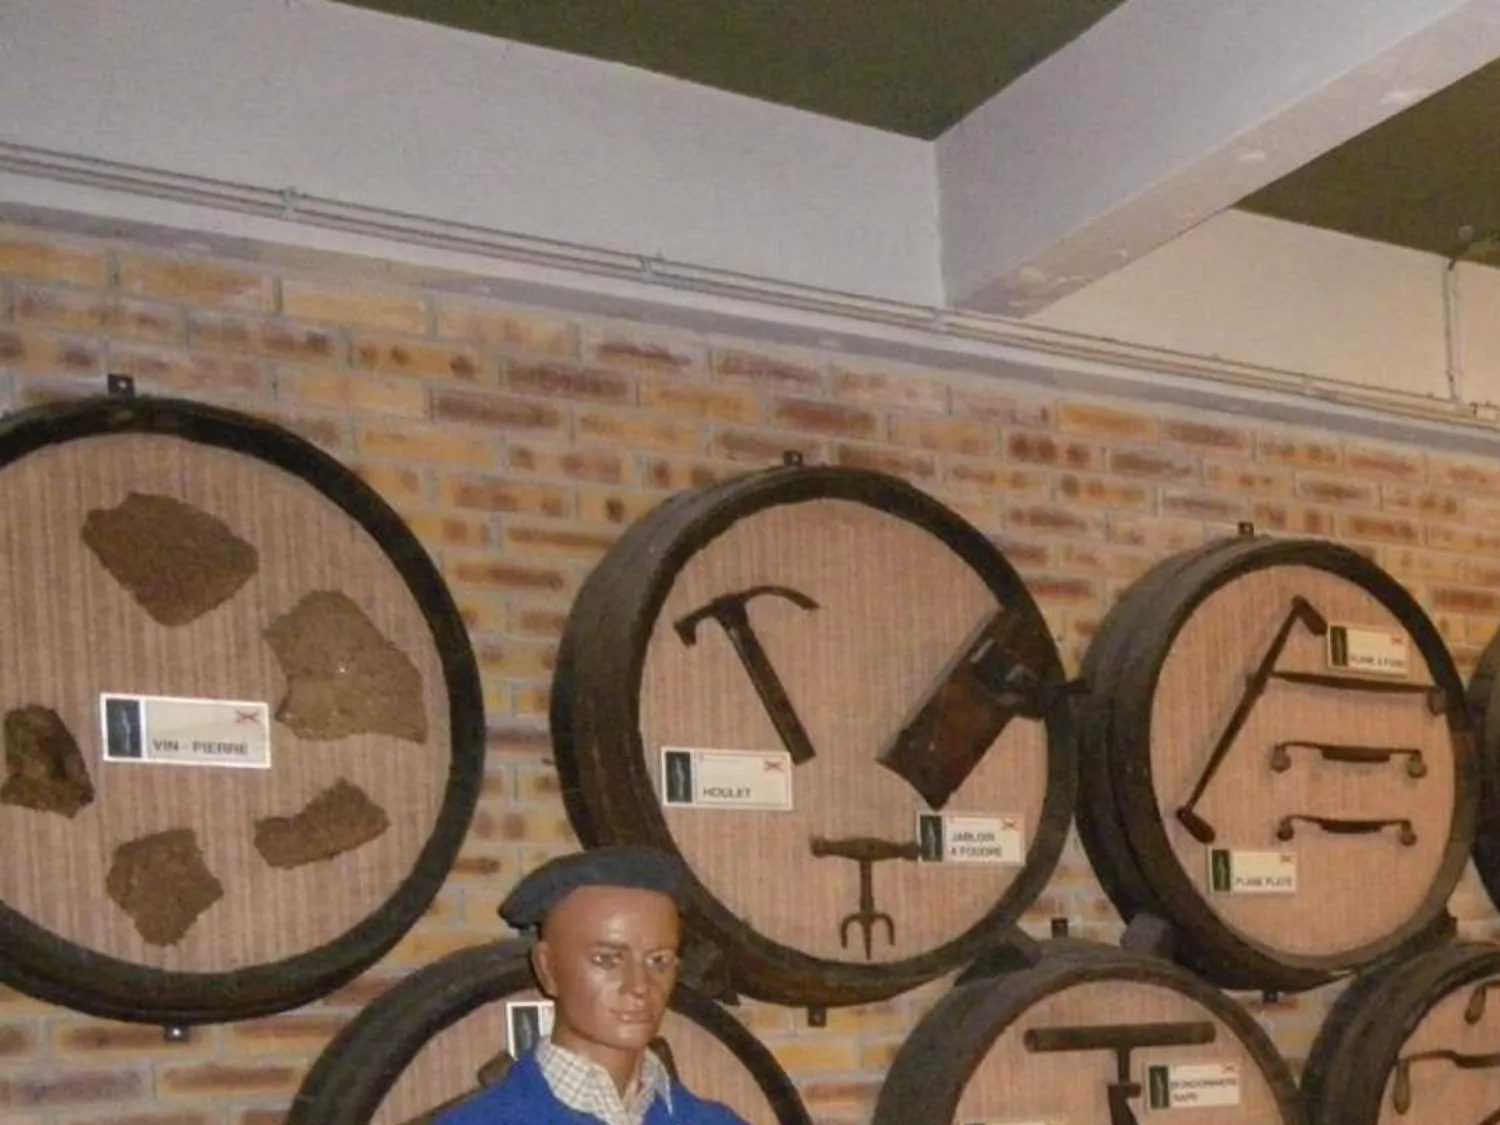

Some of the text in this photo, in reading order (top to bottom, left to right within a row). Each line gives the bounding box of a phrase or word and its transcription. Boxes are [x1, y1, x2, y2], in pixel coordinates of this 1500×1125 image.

[152, 740, 180, 754] VIN
[193, 741, 249, 757] PIERRE
[702, 787, 752, 800] HOULET
